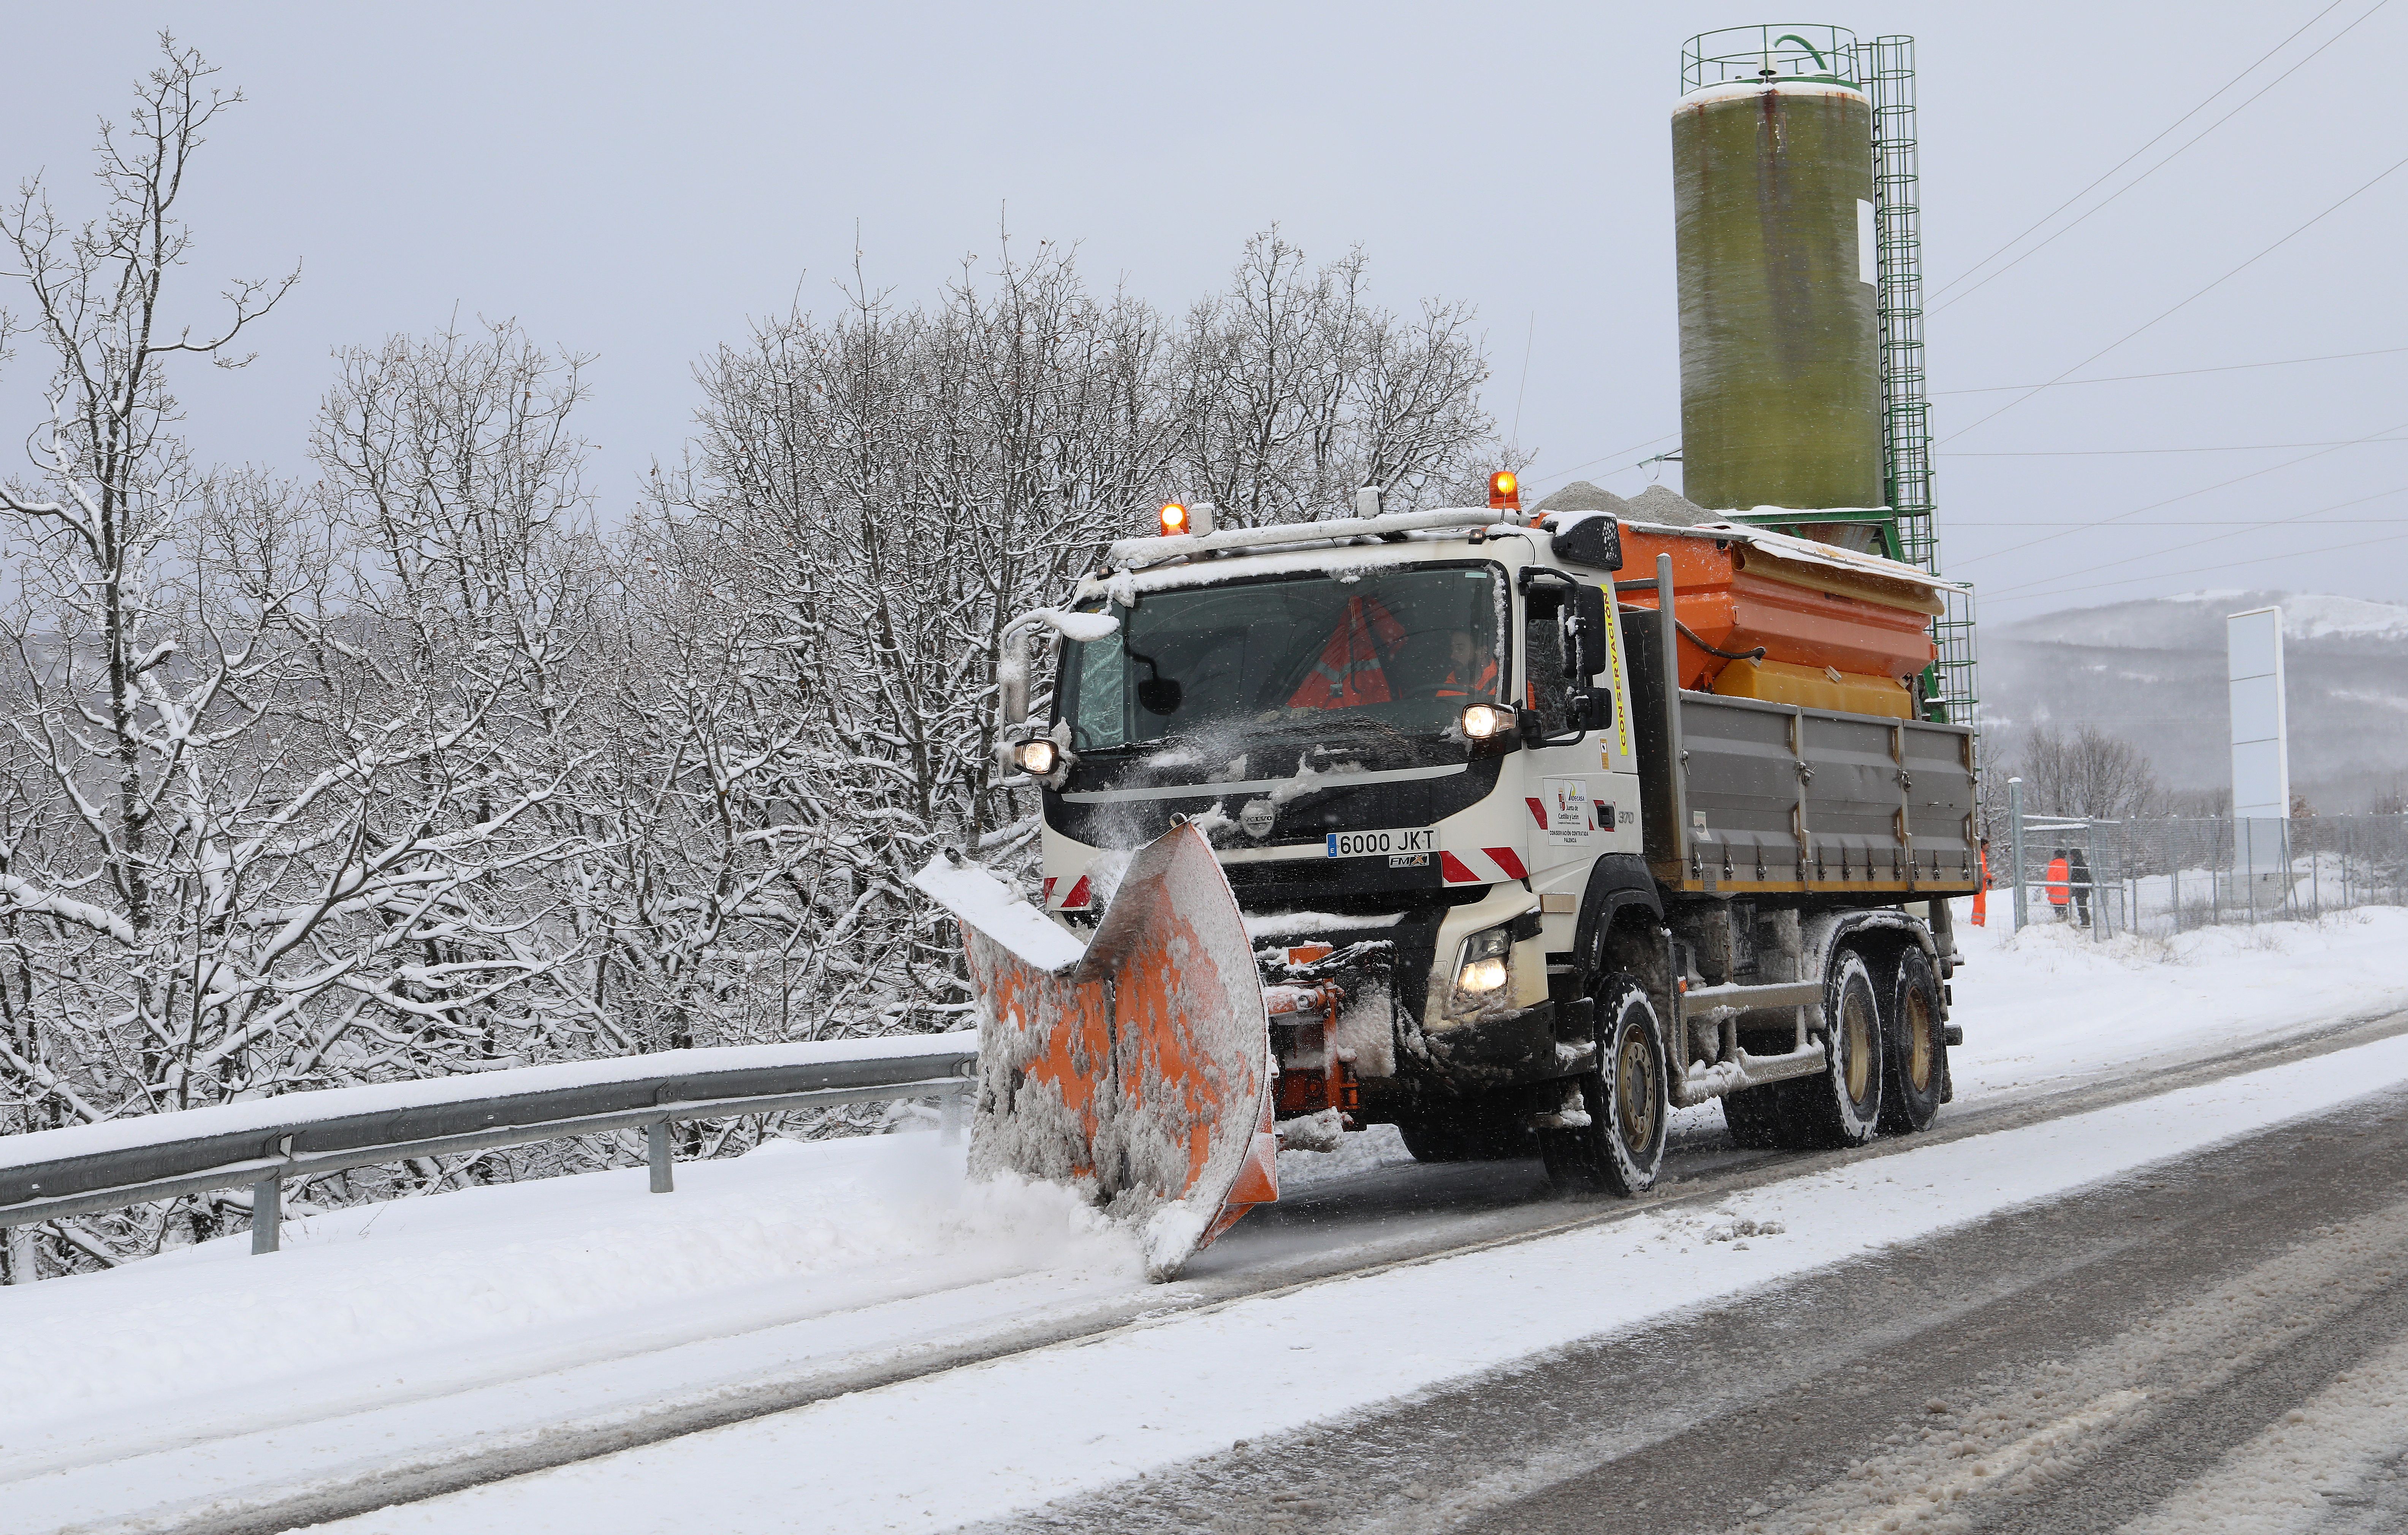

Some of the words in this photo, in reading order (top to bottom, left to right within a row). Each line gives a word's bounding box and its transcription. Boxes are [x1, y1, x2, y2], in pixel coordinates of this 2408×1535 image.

[1602, 593, 1627, 747] CONSERVACIÓN
[1618, 811, 1634, 824] 370
[1340, 833, 1390, 854] 6000
[1397, 830, 1434, 850] JKT
[1390, 854, 1428, 866] FMX
